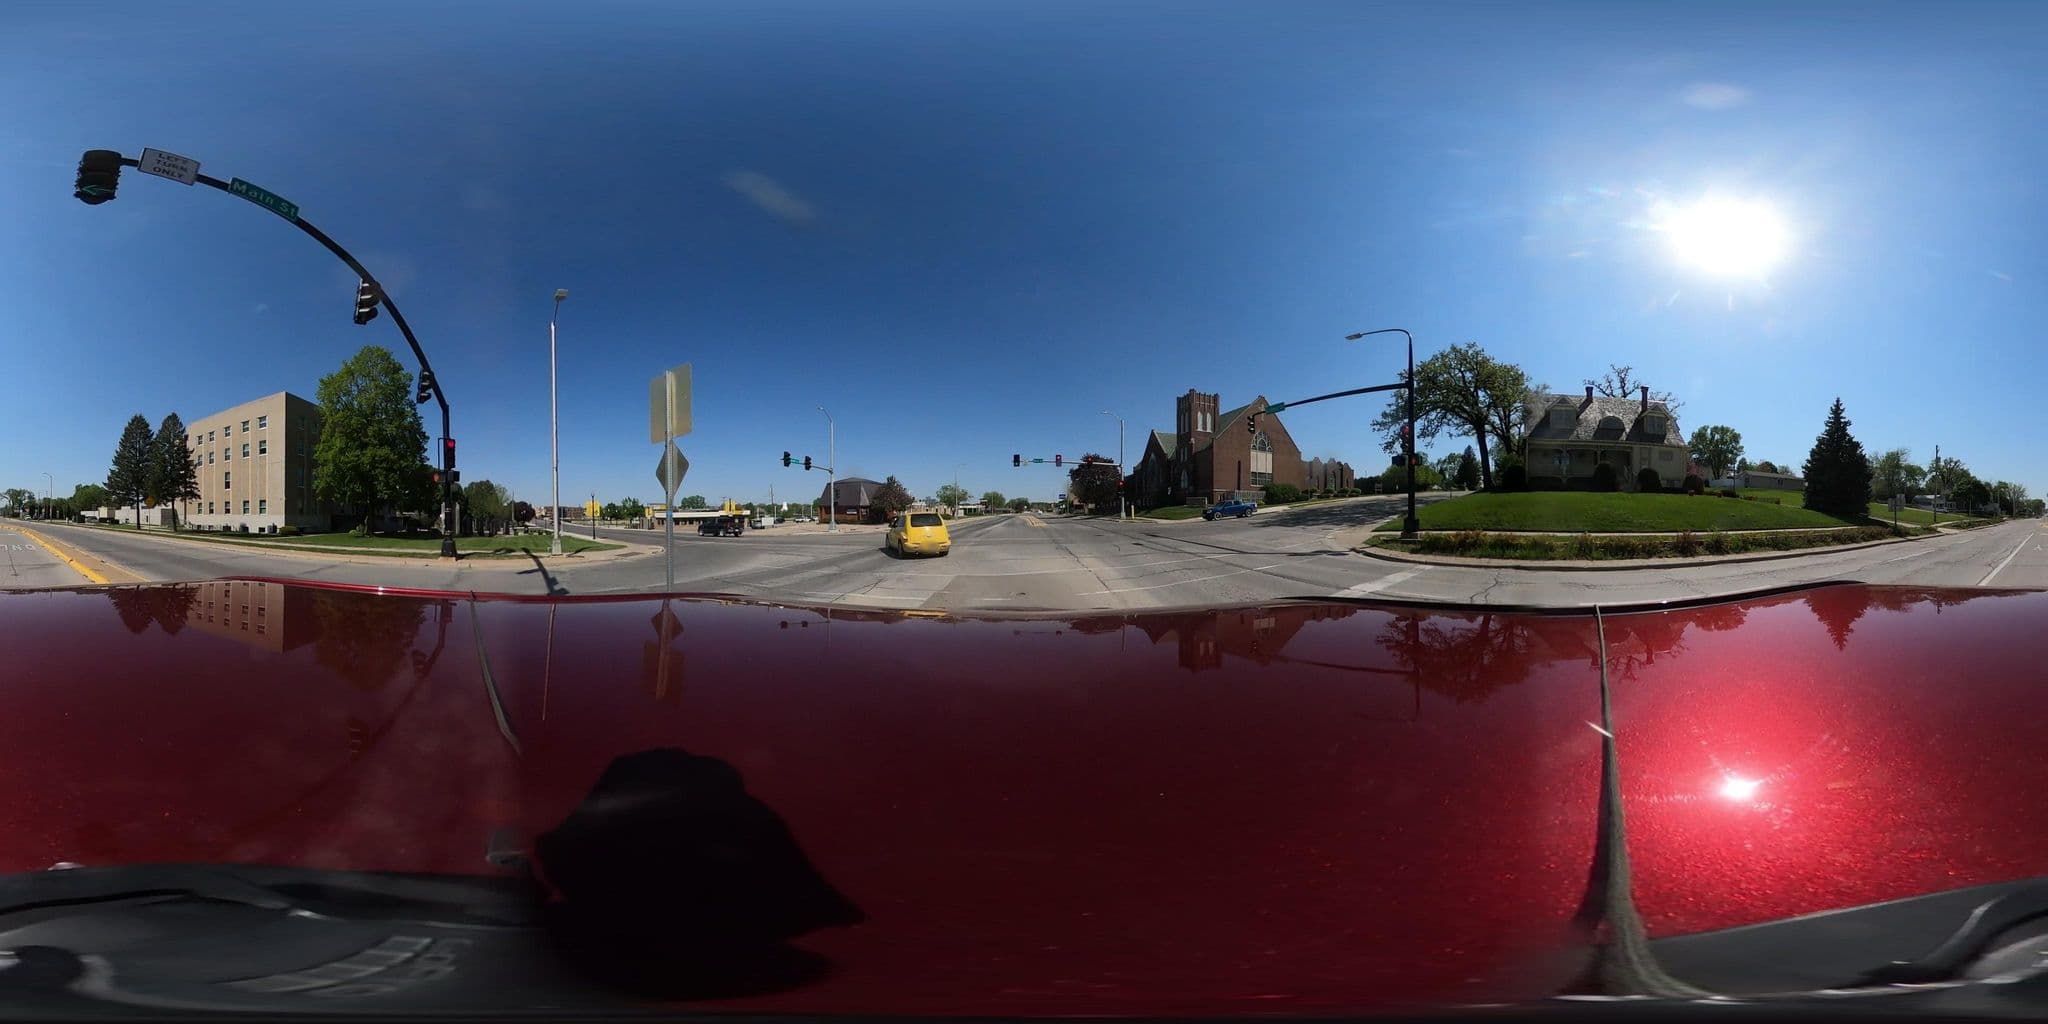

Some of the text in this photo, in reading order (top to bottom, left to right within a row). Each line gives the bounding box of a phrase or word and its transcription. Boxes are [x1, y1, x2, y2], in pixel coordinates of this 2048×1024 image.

[153, 166, 184, 179] ONLY
[156, 159, 188, 173] TURN
[232, 181, 296, 218] Main St
